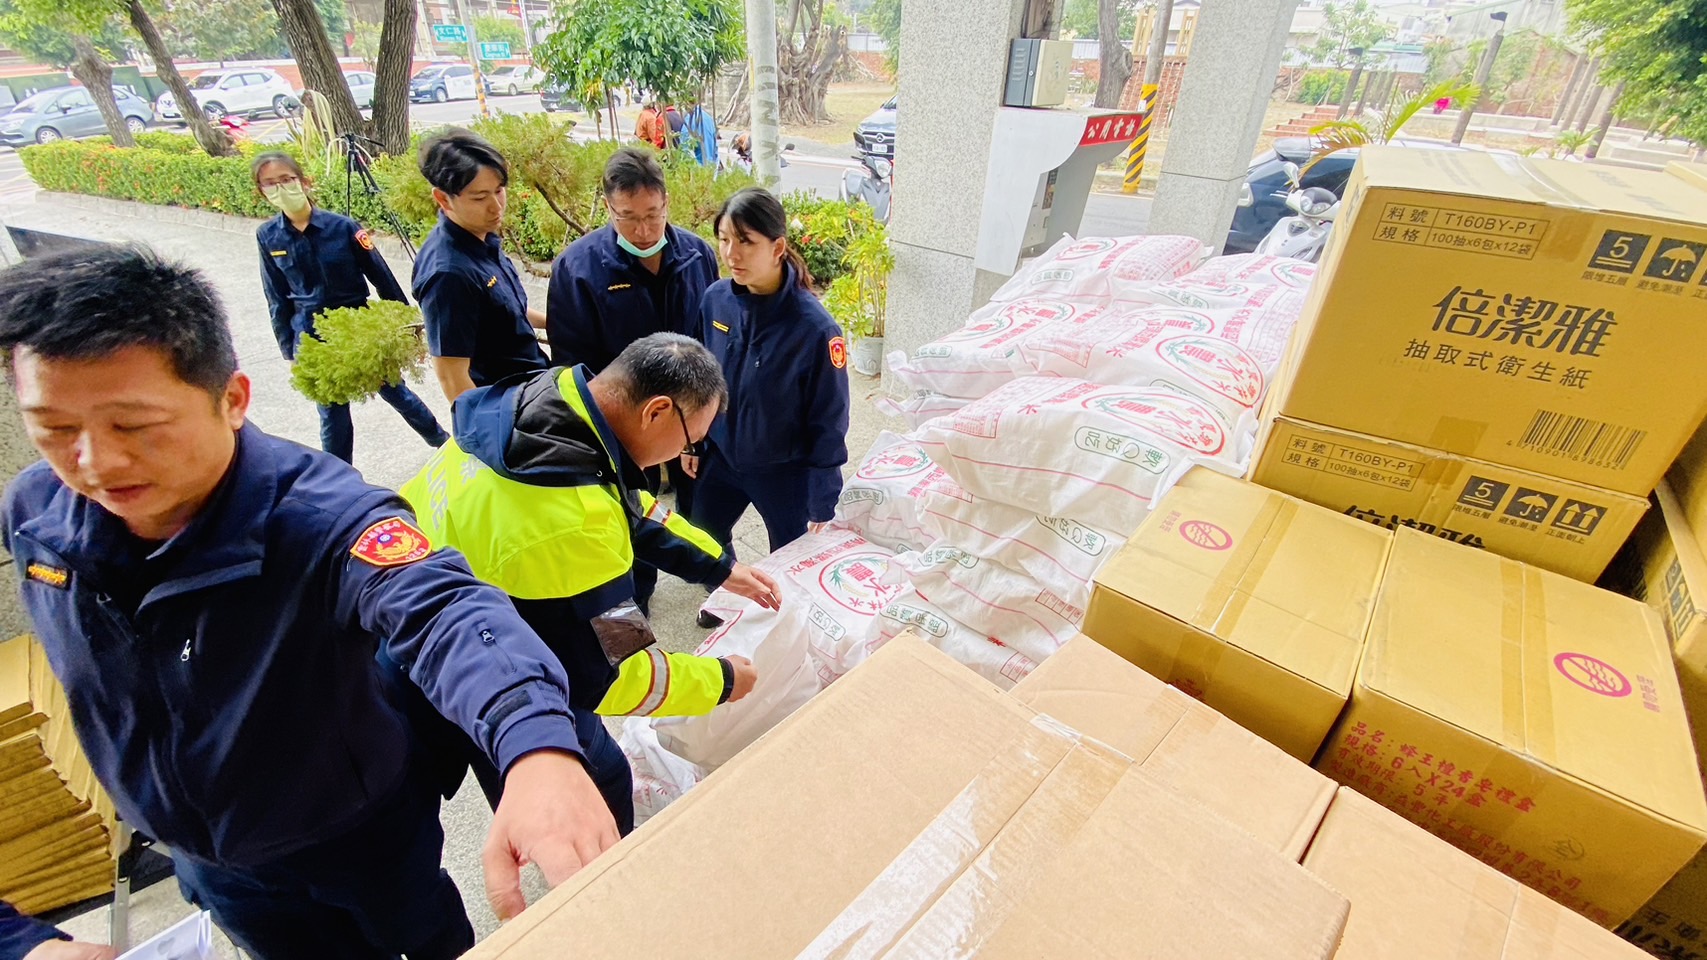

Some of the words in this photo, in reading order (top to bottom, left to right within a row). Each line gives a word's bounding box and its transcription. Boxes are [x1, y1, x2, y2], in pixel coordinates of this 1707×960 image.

[1388, 206, 1428, 225] 料號
[1443, 212, 1538, 236] T160BY-P1
[1378, 226, 1419, 243] 規格
[1431, 233, 1533, 257] 100抽x6包x12袋
[1609, 236, 1633, 258] 5
[1432, 285, 1619, 358] 倍潔雅
[1403, 338, 1594, 390] 抽取式衛生紙
[1085, 430, 1163, 468] 軟Q好吃
[1287, 452, 1320, 468] 規格
[1293, 437, 1327, 455] 料號
[1338, 447, 1415, 474] T160BY-P1
[427, 453, 449, 531] LICE
[1475, 482, 1494, 498] 5
[1545, 529, 1585, 545] 正面朝上
